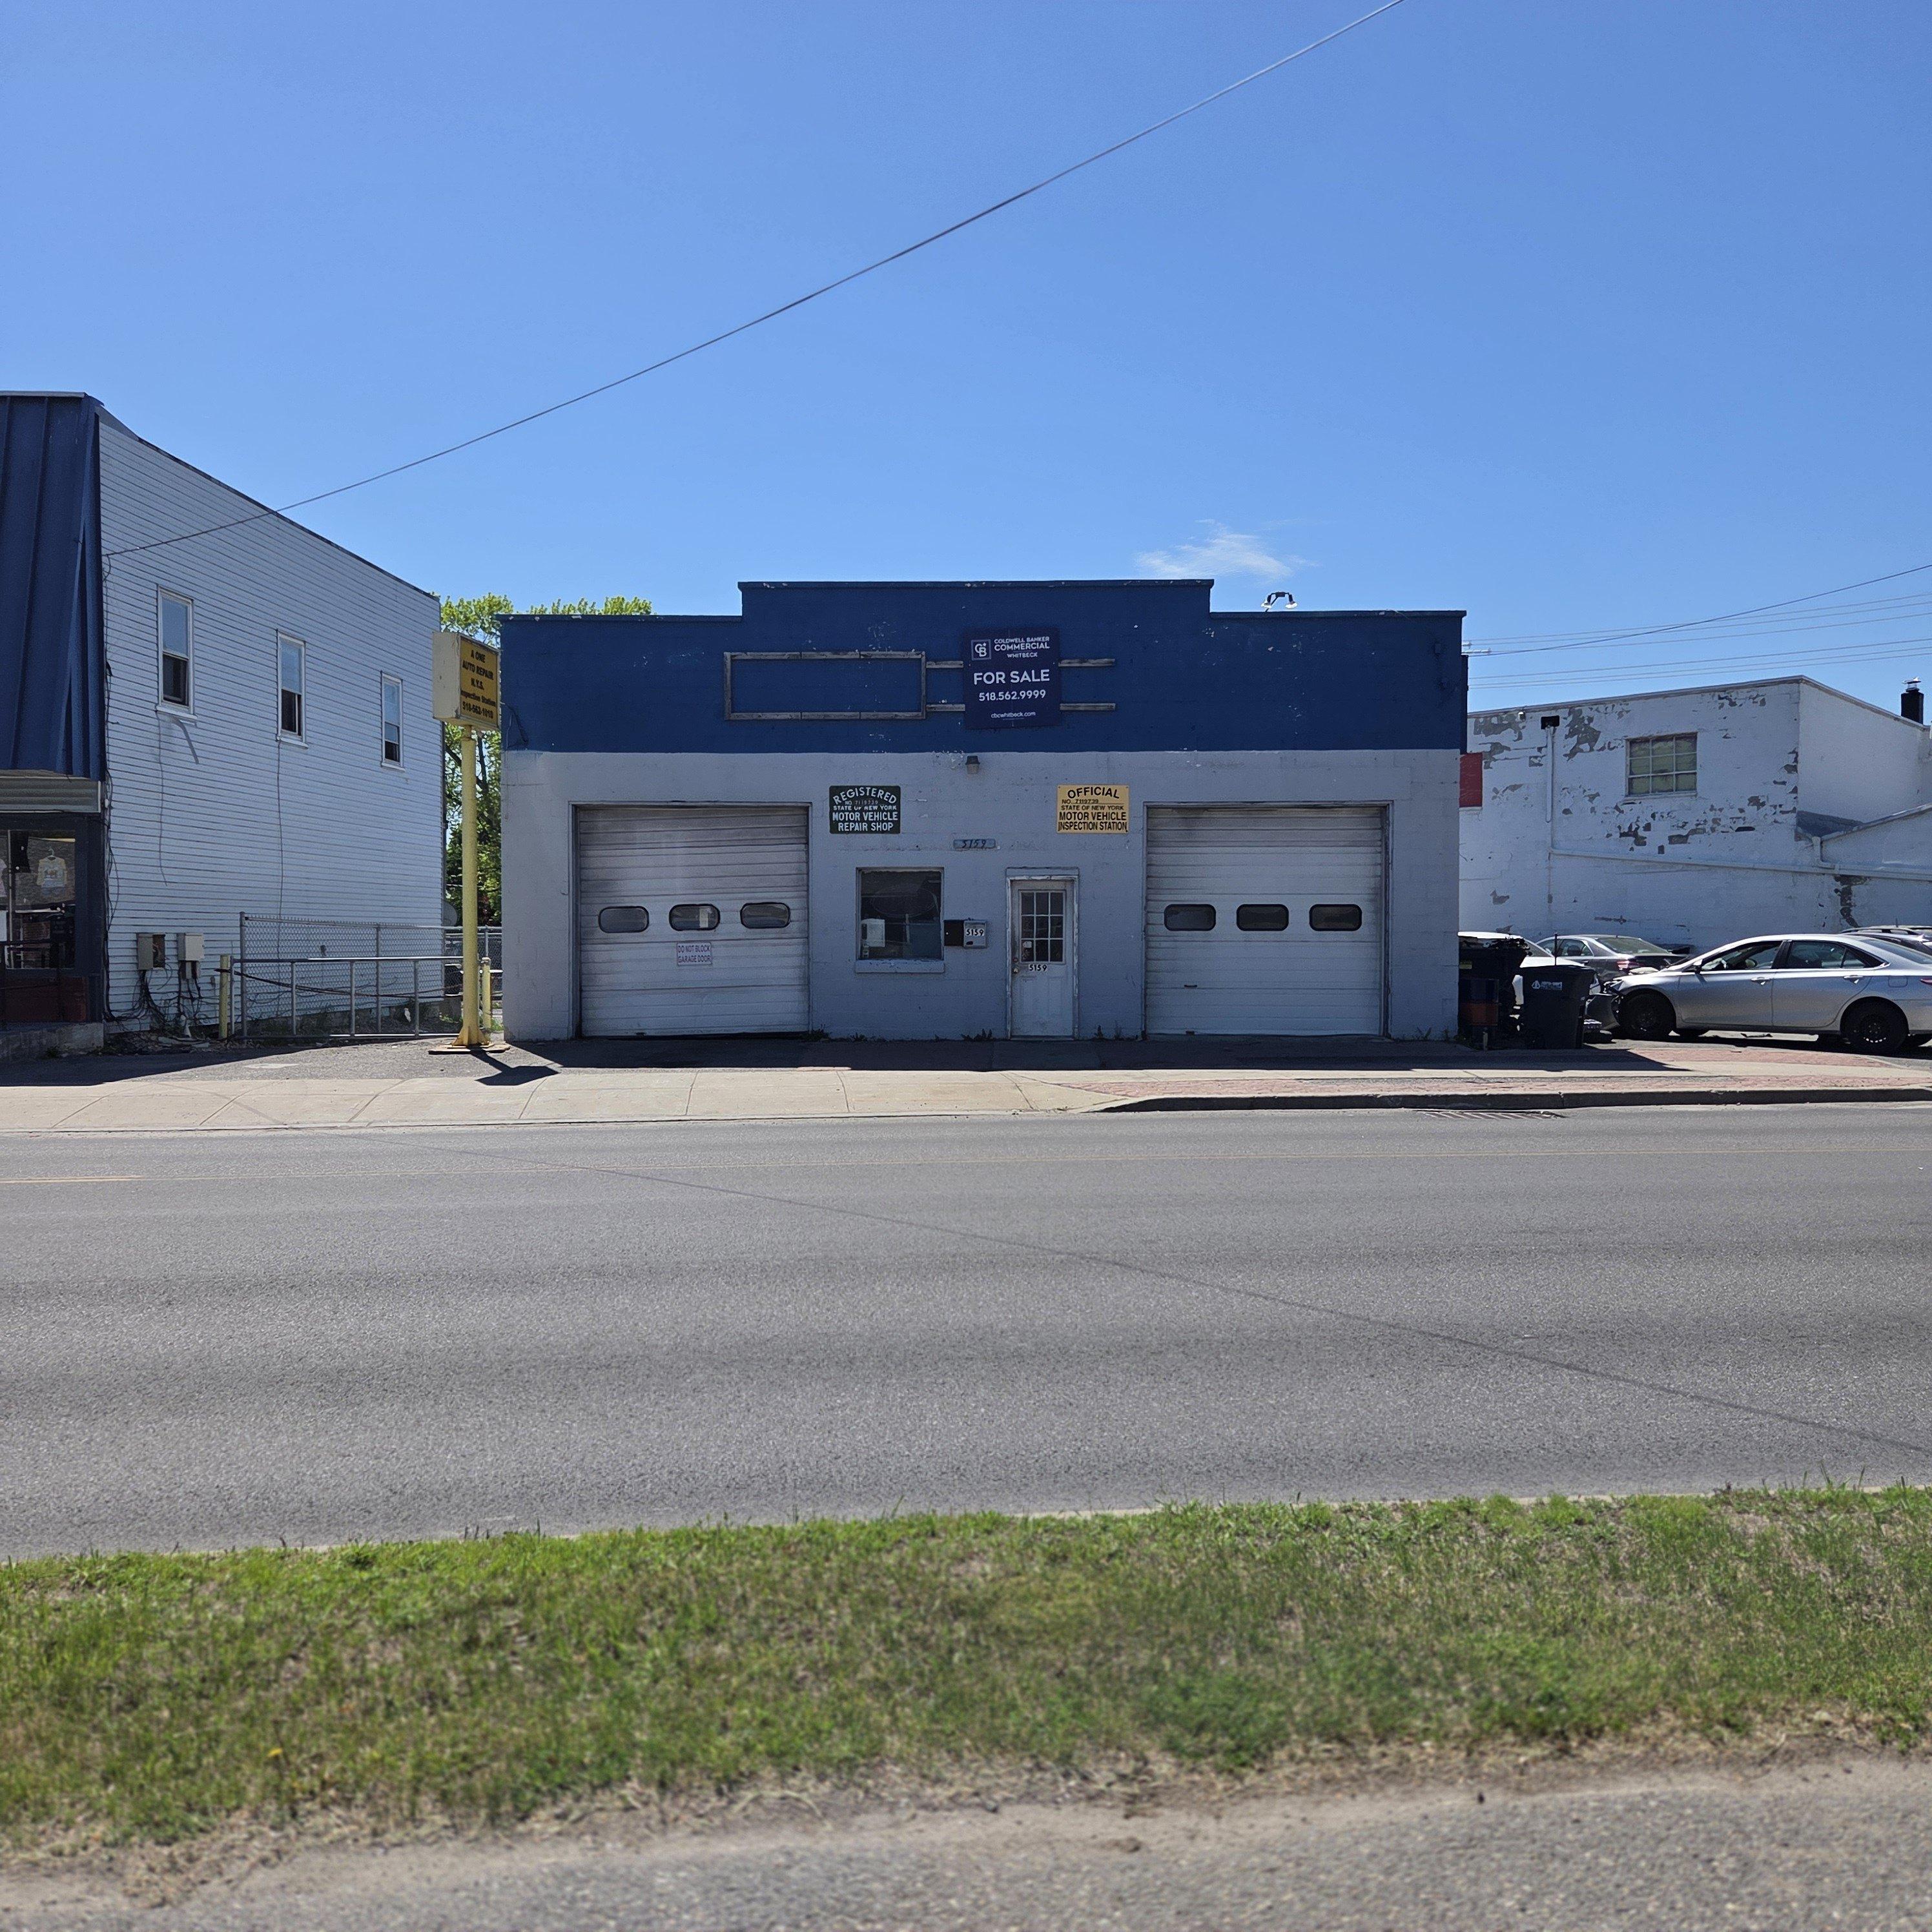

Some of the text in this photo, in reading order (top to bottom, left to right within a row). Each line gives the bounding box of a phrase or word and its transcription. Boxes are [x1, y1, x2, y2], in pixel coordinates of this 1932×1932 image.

[994, 642, 1050, 652] COMMERCIAL
[471, 650, 475, 659] A
[462, 660, 494, 681] AUTO REPAIR
[974, 669, 1050, 684] FOR SALE
[979, 689, 1046, 701] 518.562.9999
[833, 787, 897, 805] REGISTERED
[1067, 786, 1120, 799] OFFICIAL
[832, 812, 898, 821] MOTOR VEHICLE
[1059, 812, 1126, 821] MOTOR VEHICLE
[838, 822, 894, 832] REPAIR SHOP
[1058, 821, 1127, 830] INSPECTION STATION
[962, 839, 987, 848] 5159
